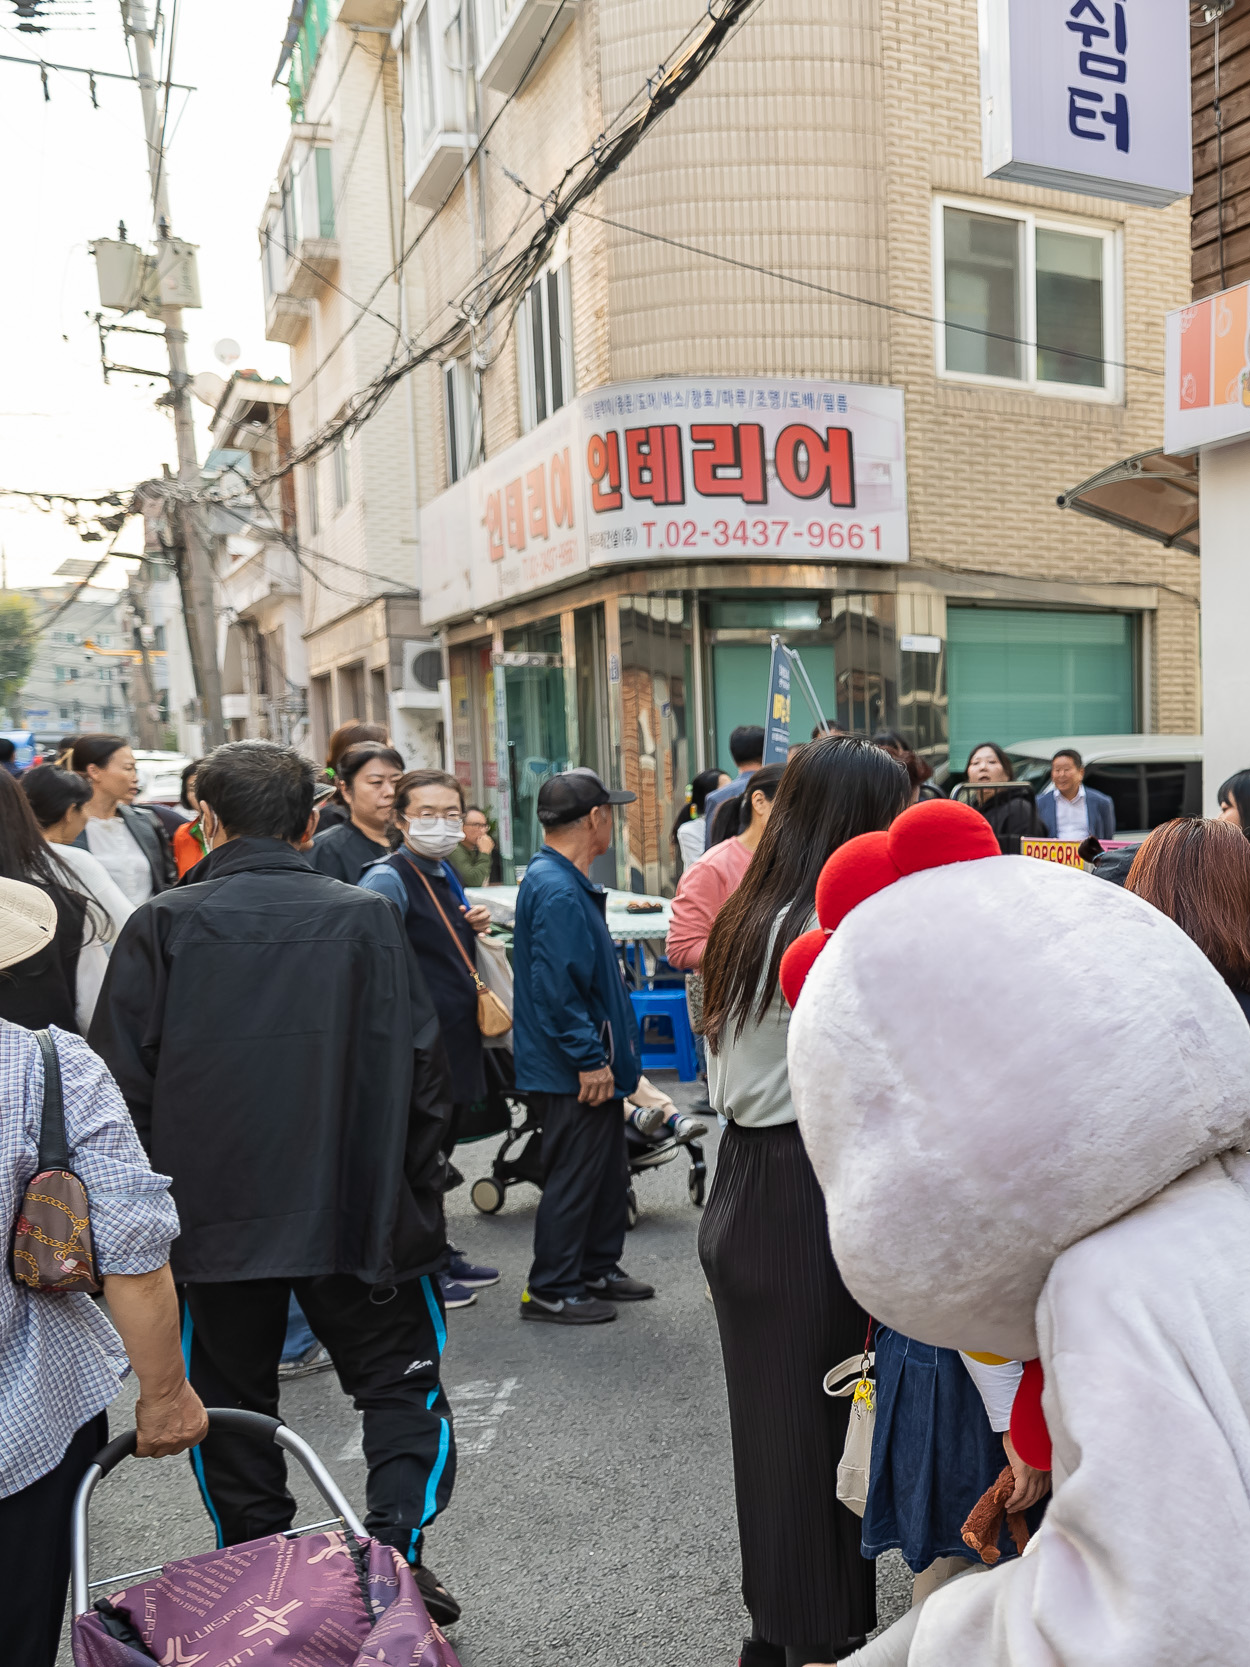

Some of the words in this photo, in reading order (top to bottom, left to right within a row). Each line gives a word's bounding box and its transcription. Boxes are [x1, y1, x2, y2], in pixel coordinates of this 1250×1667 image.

[1065, 0, 1130, 153] 쉼터
[587, 423, 856, 513] 인테리어
[642, 520, 882, 551] T.02-3437-9661
[1026, 845, 1081, 866] POPCORN
